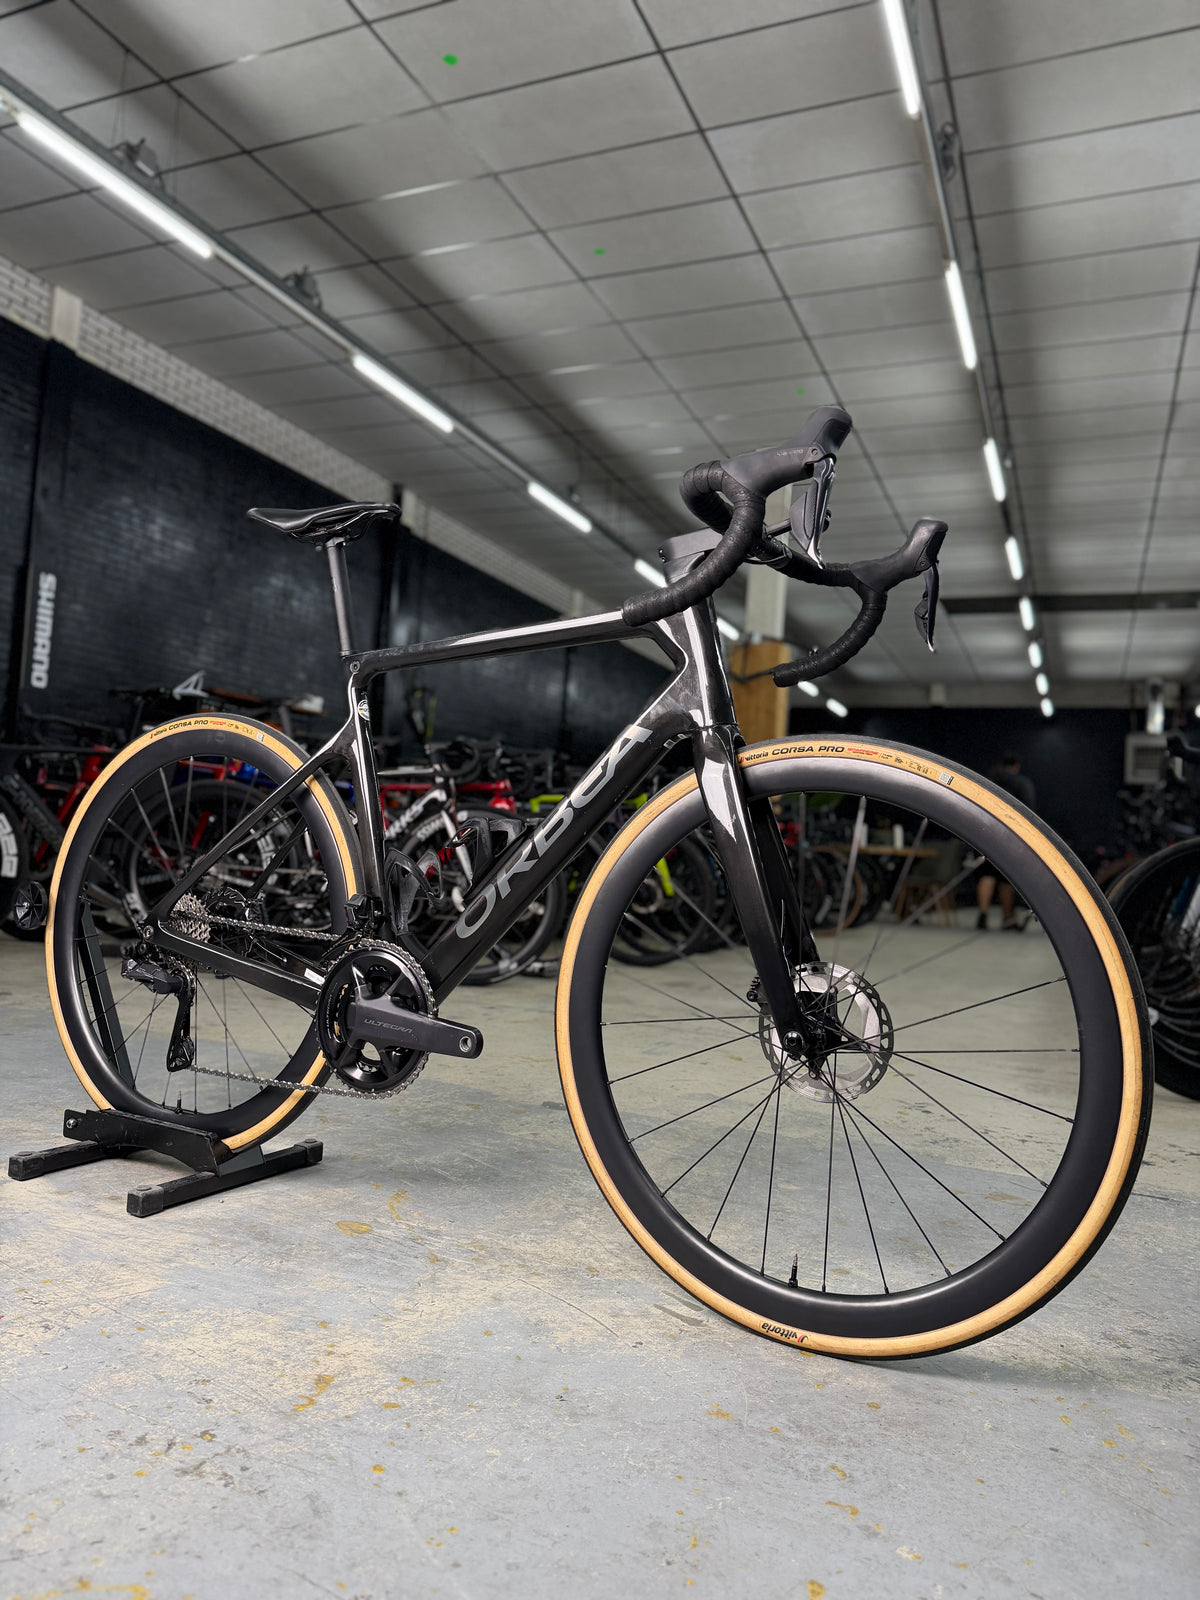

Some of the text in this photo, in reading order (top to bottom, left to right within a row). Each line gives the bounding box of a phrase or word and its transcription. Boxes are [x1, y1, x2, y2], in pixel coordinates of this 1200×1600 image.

[30, 571, 57, 689] SHIMANO
[168, 721, 192, 731] CORSA
[745, 750, 769, 762] vittoria
[772, 745, 814, 756] CORSA
[818, 745, 845, 753] PRO
[363, 1018, 413, 1034] ULTEGRA
[761, 1322, 798, 1340] vittoria
